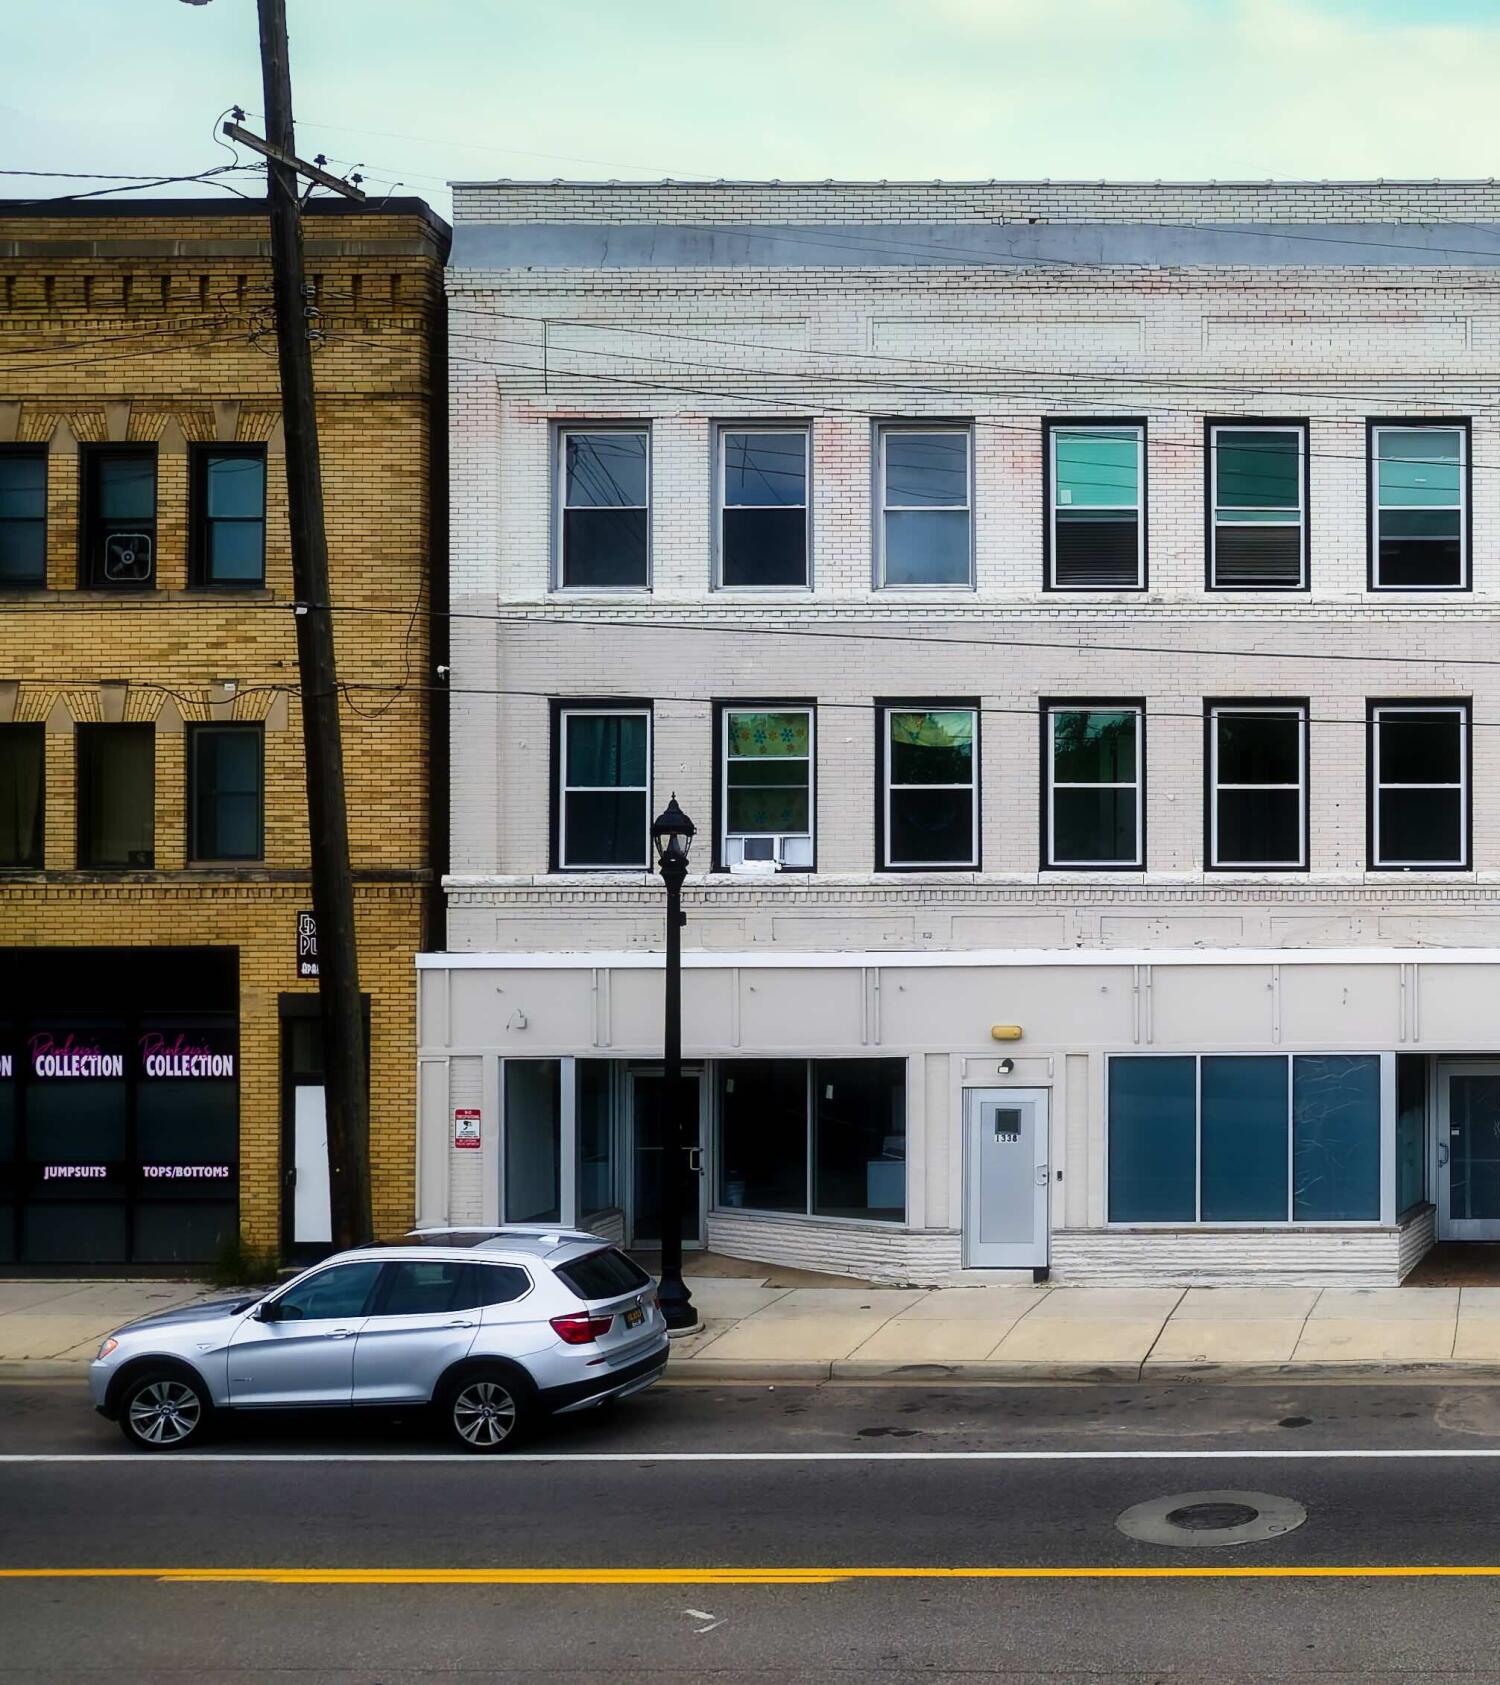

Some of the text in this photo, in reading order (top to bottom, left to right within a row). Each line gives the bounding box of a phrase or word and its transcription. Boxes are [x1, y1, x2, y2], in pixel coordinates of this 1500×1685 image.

[36, 1055, 123, 1076] COLLECTION
[146, 1055, 233, 1076] COLLECTION
[44, 1166, 107, 1179] JUMPSUITS
[143, 1166, 229, 1178] TOPS/BOTTOMS
